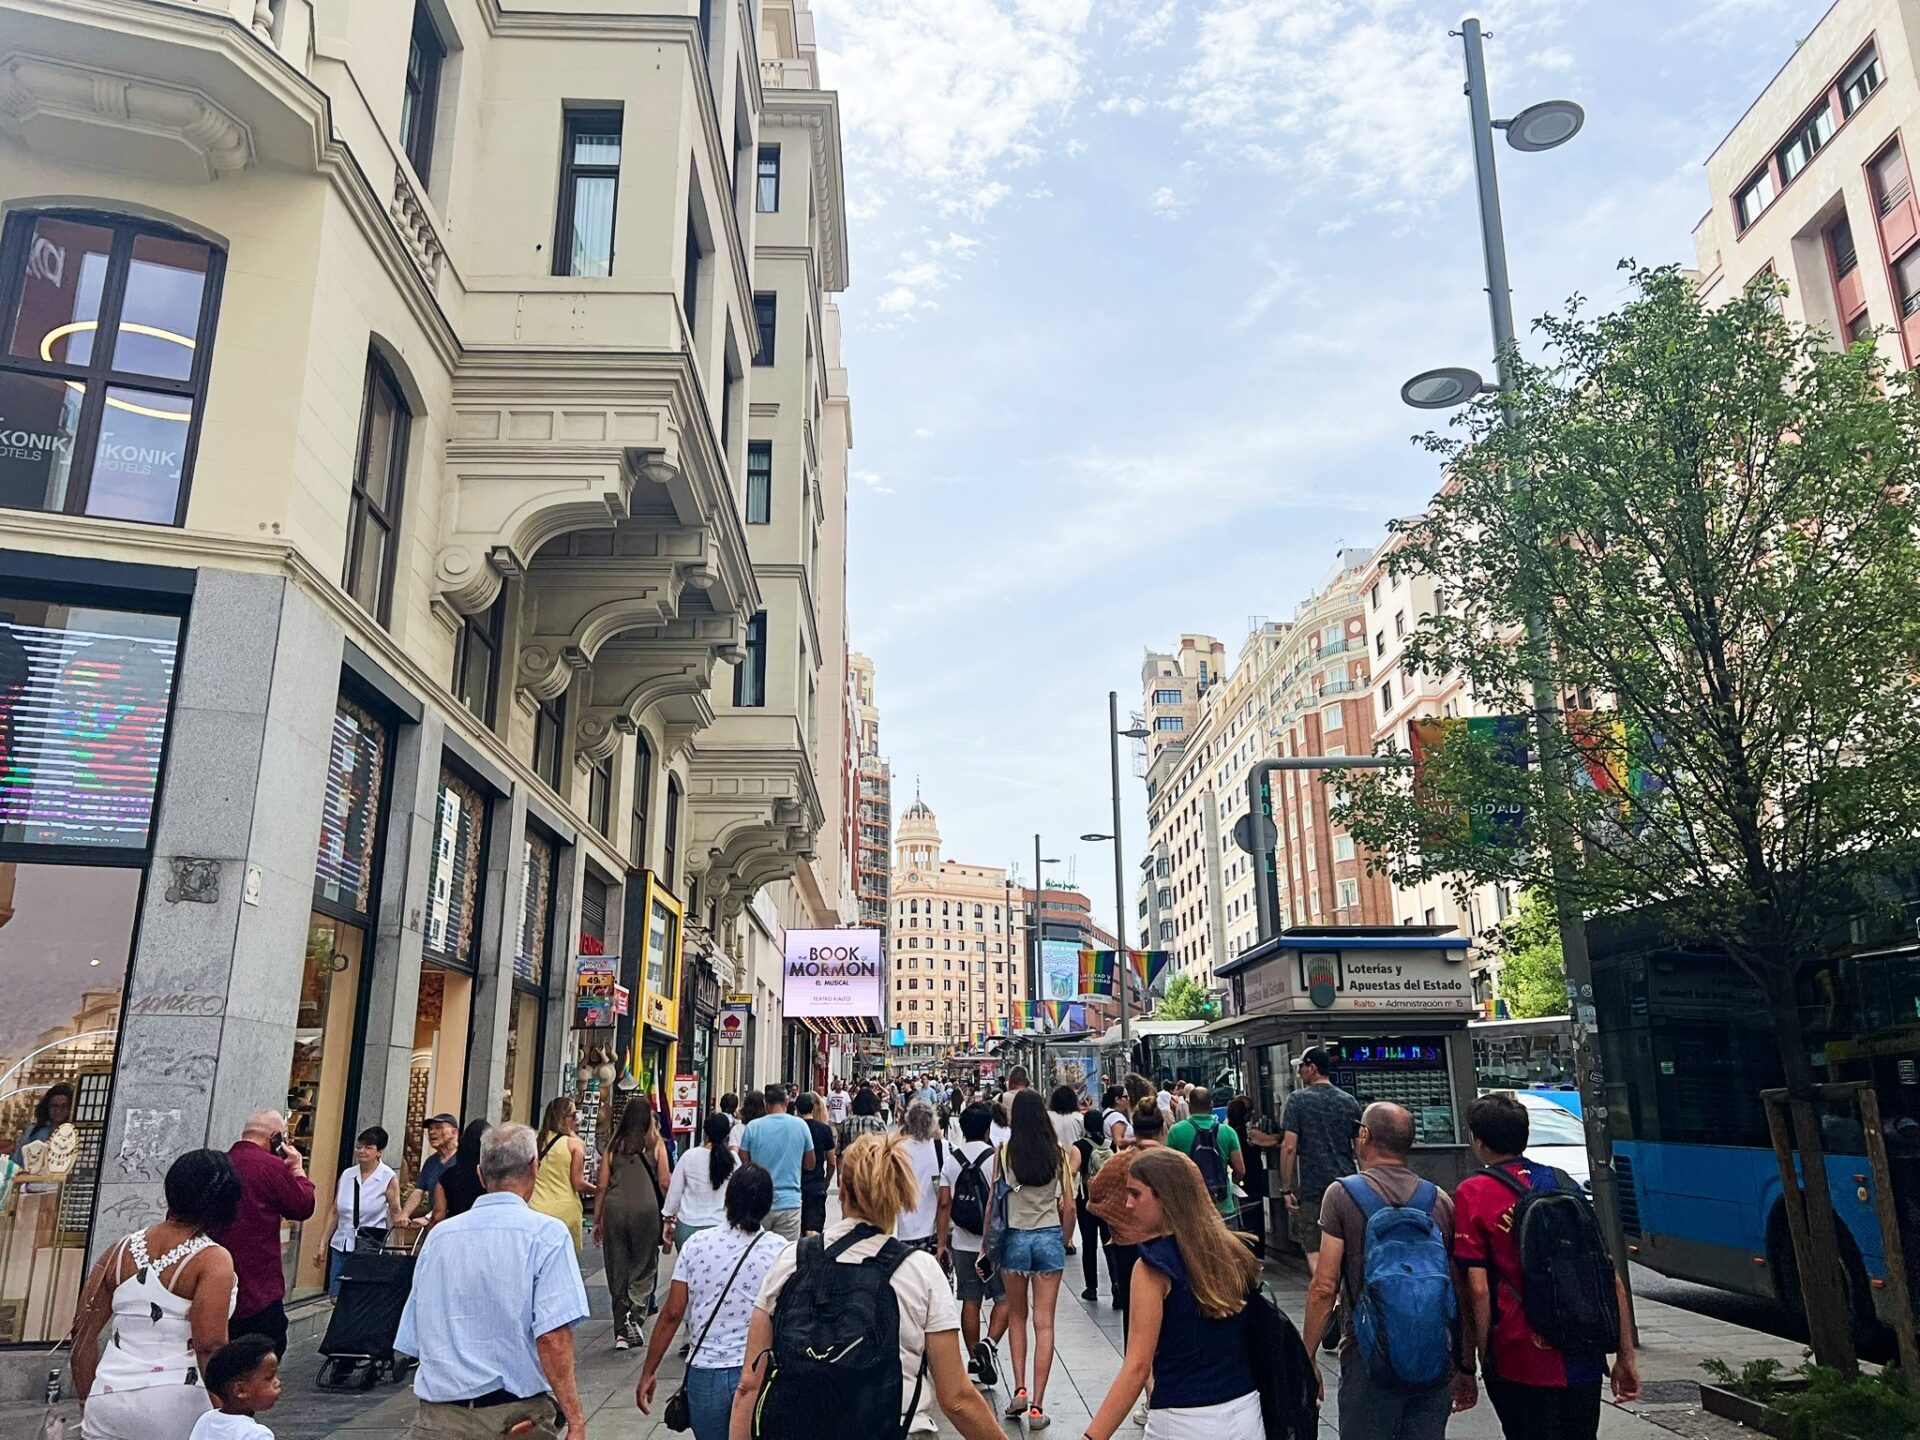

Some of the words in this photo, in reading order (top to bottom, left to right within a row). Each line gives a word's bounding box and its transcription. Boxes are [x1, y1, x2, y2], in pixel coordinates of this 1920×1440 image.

[100, 443, 177, 466] IKONIK
[98, 460, 152, 475] HOTELS
[1260, 784, 1275, 873] HOL
[810, 947, 859, 961] BOOK
[789, 962, 875, 976] MORMON
[1395, 965, 1402, 976] y
[1349, 980, 1400, 992] Apuestas
[1404, 980, 1420, 990] del
[1423, 980, 1462, 990] Estado
[1354, 1000, 1376, 1008] Rialto
[1386, 1000, 1443, 1008] Administración
